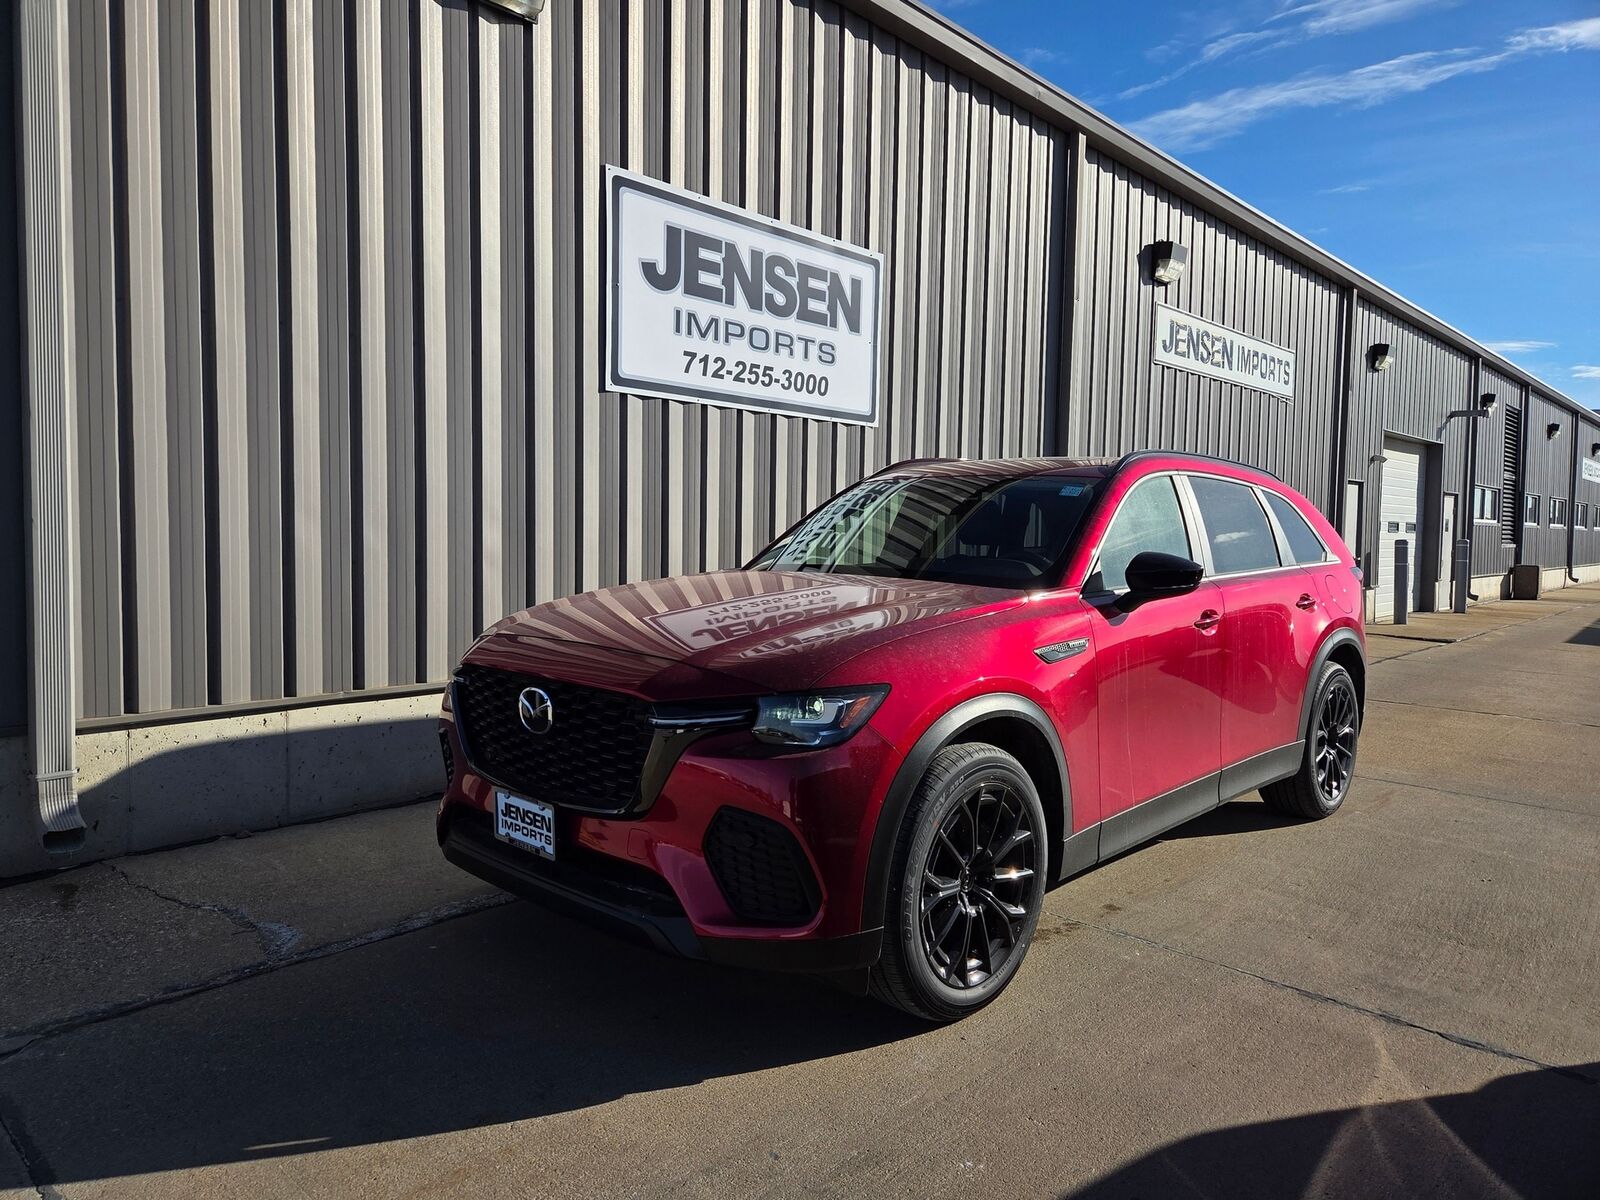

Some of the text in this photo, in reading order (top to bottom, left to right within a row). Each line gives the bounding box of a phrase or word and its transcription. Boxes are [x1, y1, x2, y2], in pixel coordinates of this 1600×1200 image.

[639, 222, 863, 335] JENSEN
[673, 307, 837, 366] IMPORTS
[1162, 319, 1291, 386] JENSEN IMPORTS
[682, 350, 829, 397] 712-255-3000
[501, 802, 552, 833] JENSEN
[501, 818, 552, 846] IMPORTS
